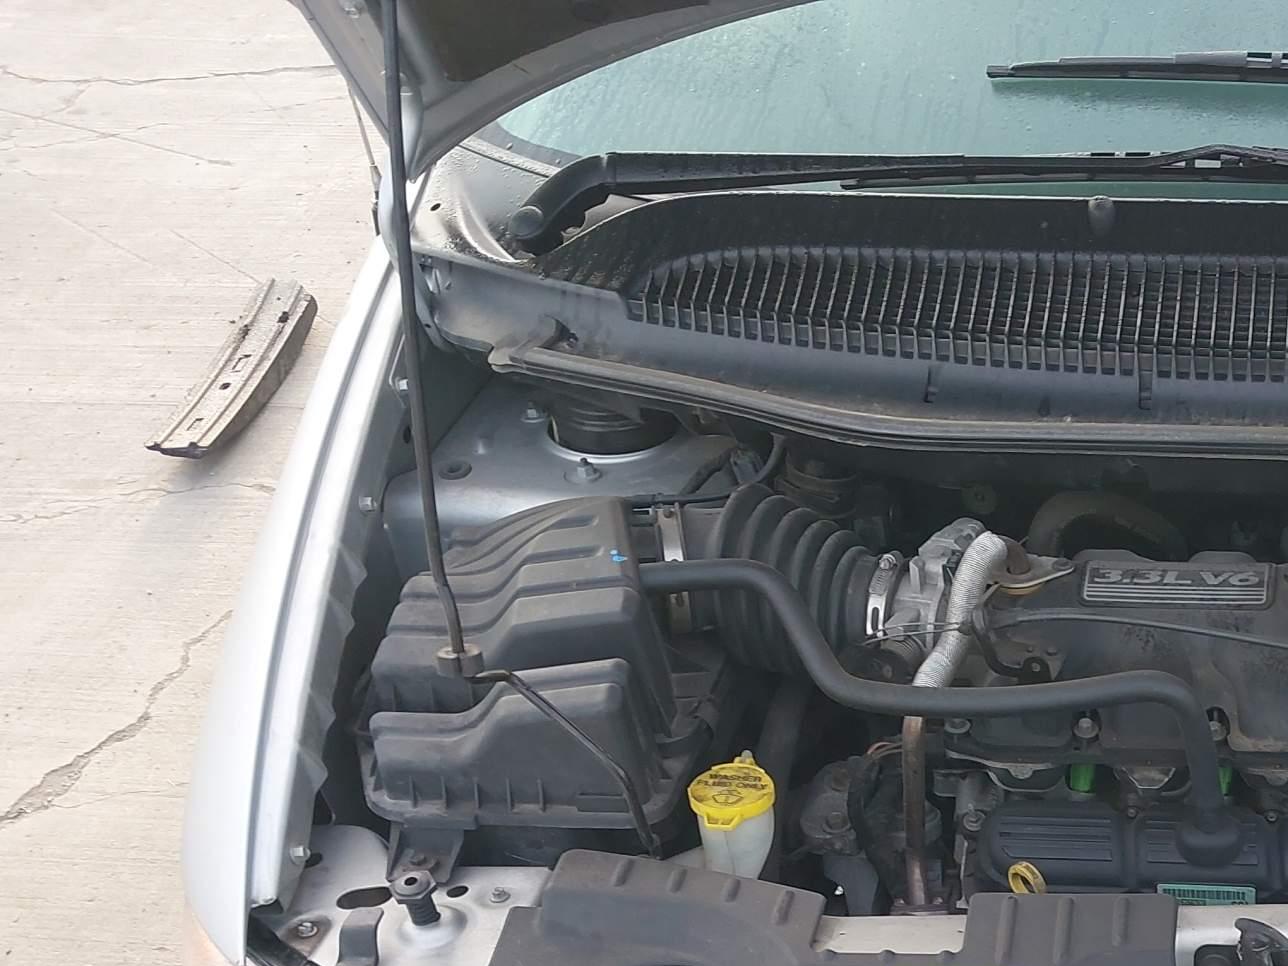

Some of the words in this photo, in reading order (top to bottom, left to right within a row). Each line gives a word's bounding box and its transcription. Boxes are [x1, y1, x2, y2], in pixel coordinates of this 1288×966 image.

[1094, 569, 1192, 585] 3.3L
[1200, 571, 1259, 586] V6
[709, 773, 763, 783] WASHER
[697, 780, 733, 788] FLUID
[735, 782, 769, 790] ONLY
